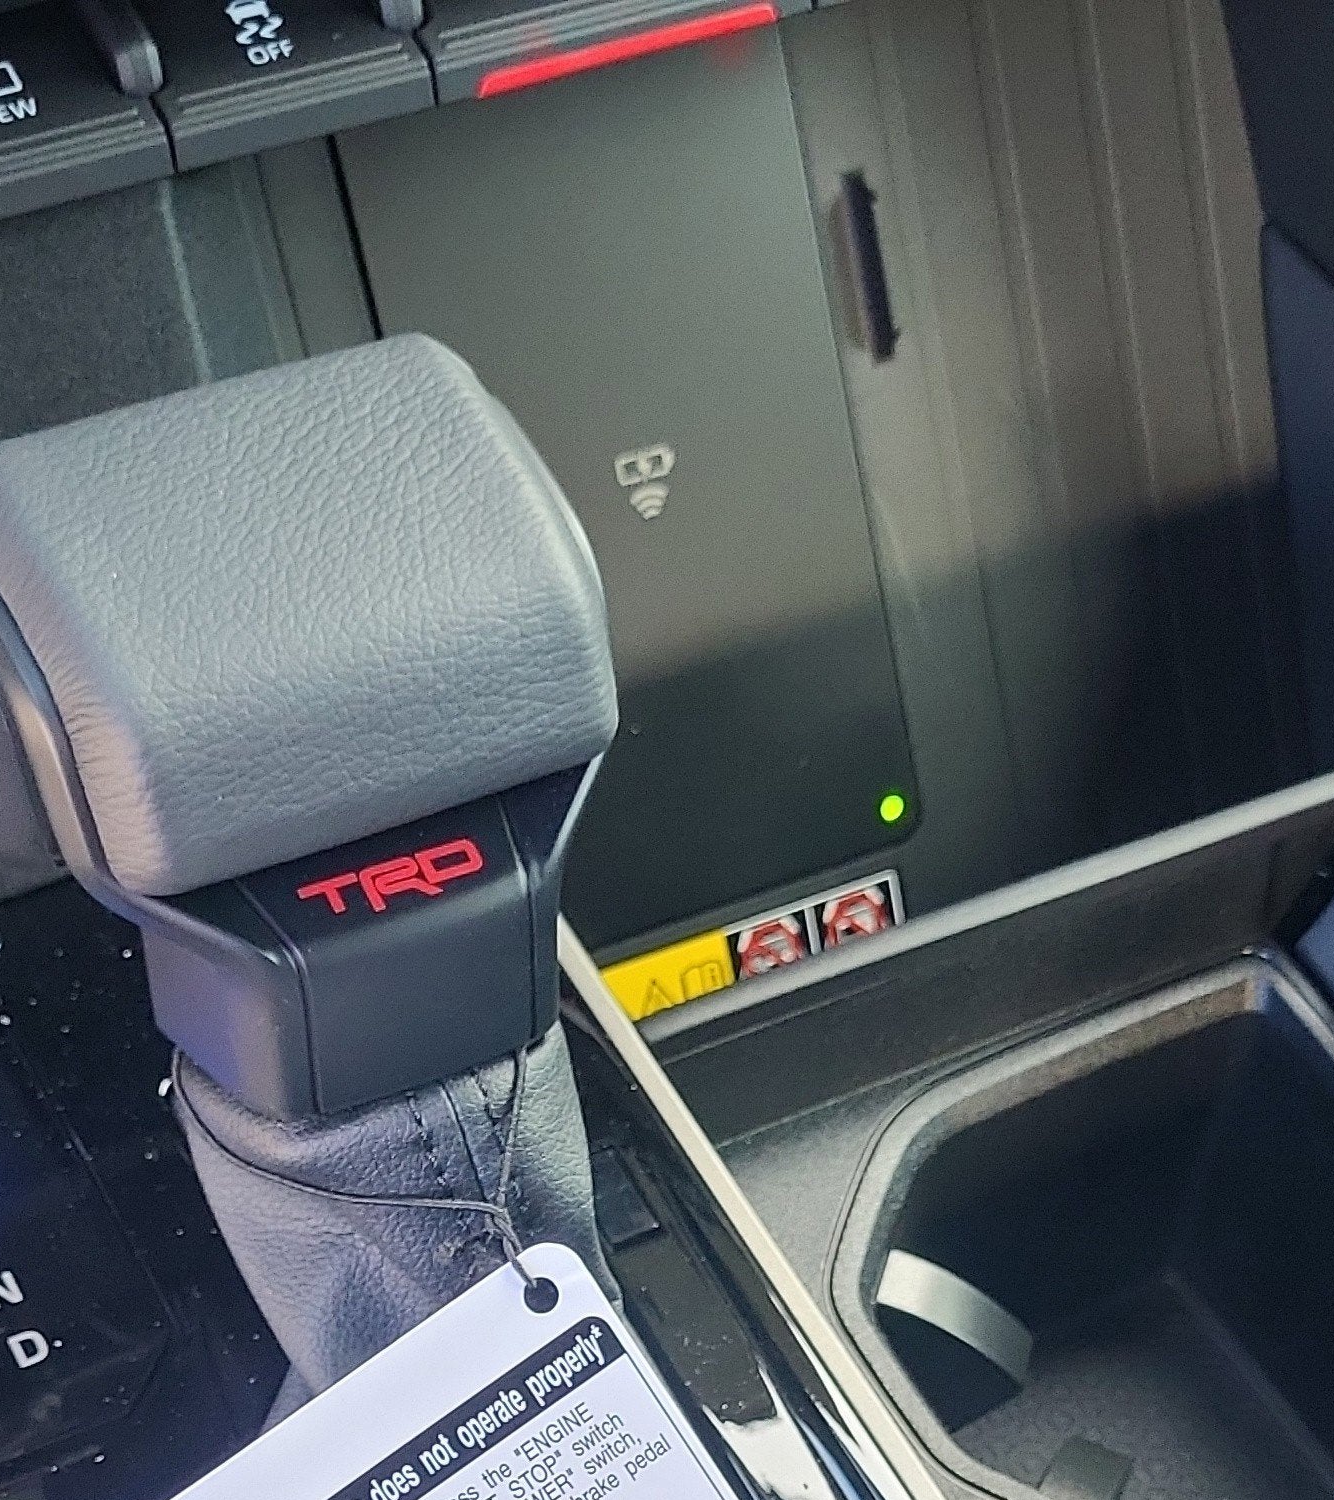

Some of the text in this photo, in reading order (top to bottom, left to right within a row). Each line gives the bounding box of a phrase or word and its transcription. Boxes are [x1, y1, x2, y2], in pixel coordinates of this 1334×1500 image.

[246, 38, 294, 66] OFF
[297, 838, 484, 915] TRD
[6, 1330, 49, 1369] D
[418, 1433, 459, 1475] not
[456, 1389, 527, 1449] operate
[571, 1413, 625, 1457] switch
[583, 1432, 642, 1476] switch,
[623, 1432, 672, 1482] pedal
